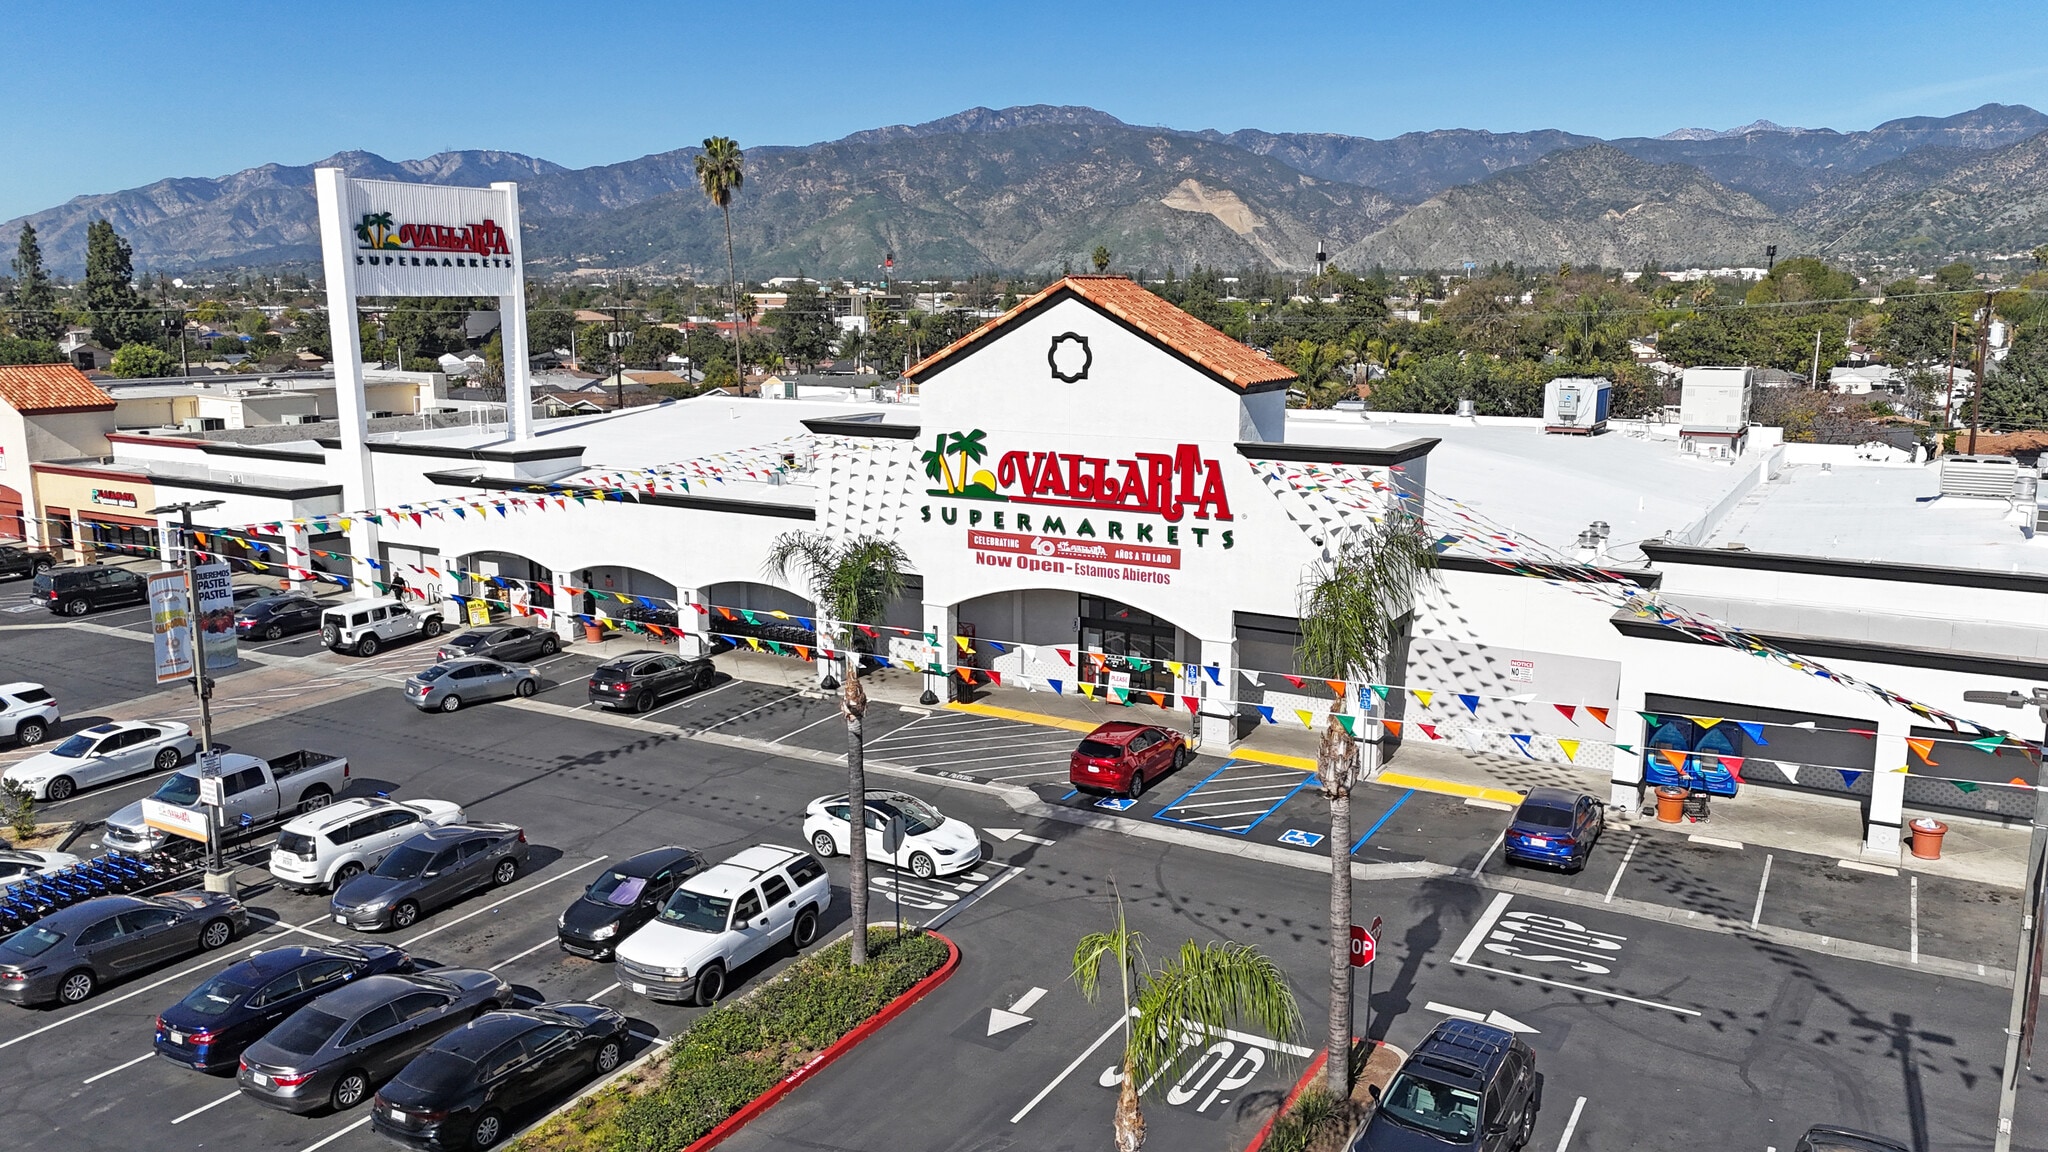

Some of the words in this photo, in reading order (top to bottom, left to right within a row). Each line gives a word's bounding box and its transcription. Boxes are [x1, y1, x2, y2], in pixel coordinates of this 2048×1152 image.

[400, 219, 511, 256] VALLARTA
[356, 255, 512, 268] SUPERMARKETS
[998, 444, 1234, 522] VALLARTA
[921, 505, 1234, 549] SUPERMARKETS
[974, 535, 1020, 549] CELEBRATING
[1030, 536, 1055, 556] 40
[1115, 549, 1134, 560] AÑOS
[1134, 552, 1140, 560] A
[1141, 552, 1151, 561] TU
[1152, 554, 1172, 564] LADO
[976, 551, 1012, 567] Now
[1017, 556, 1065, 573] Open
[1075, 563, 1120, 579] Estamos
[1122, 567, 1171, 584] Abiertos
[1350, 937, 1373, 956] OP
[1483, 911, 1628, 975] STOP
